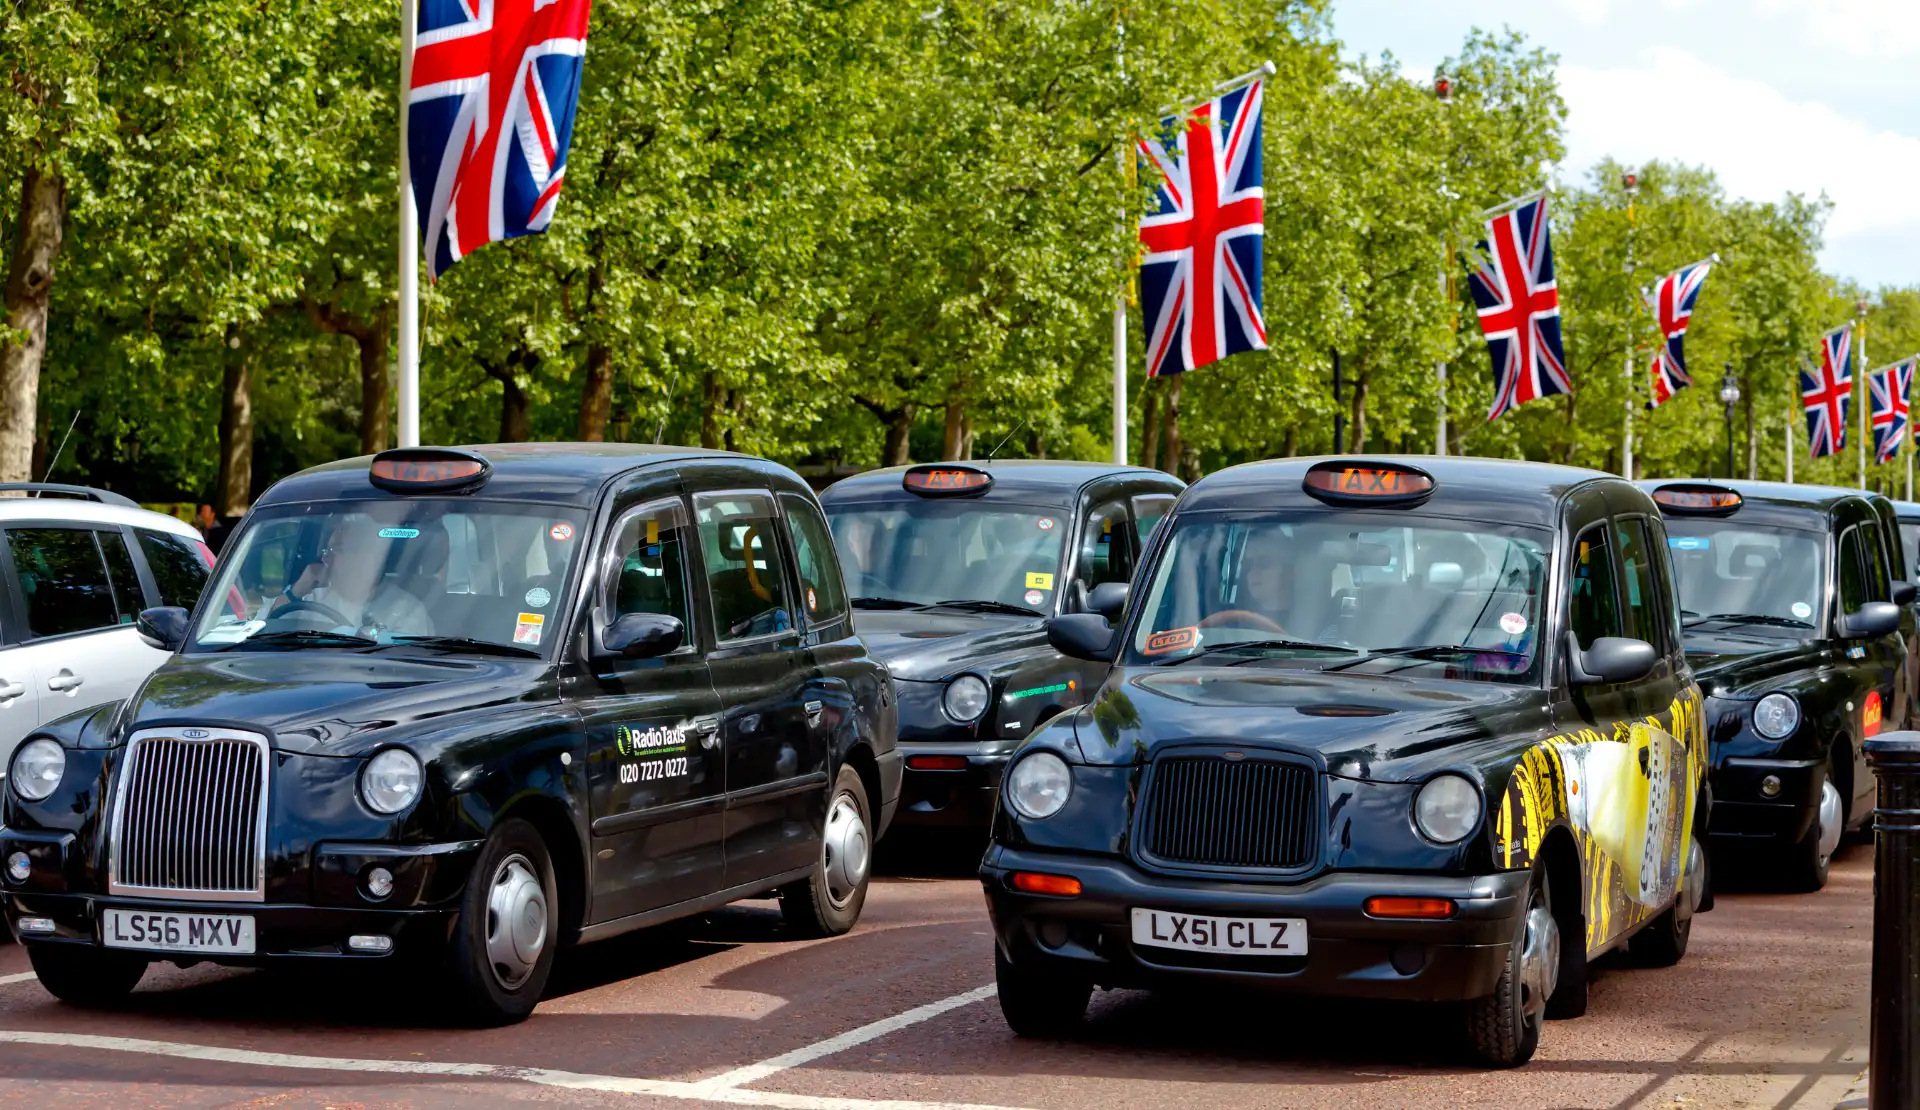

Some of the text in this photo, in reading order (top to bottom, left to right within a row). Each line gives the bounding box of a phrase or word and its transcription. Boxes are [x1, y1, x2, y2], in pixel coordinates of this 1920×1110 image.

[919, 471, 969, 488] TAXI
[1328, 469, 1401, 491] TAXI
[1154, 633, 1186, 646] LTDA
[620, 757, 688, 784] 020 7272 0272
[114, 913, 242, 947] LS56 MXV
[1151, 913, 1289, 949] LX51 CLZ
